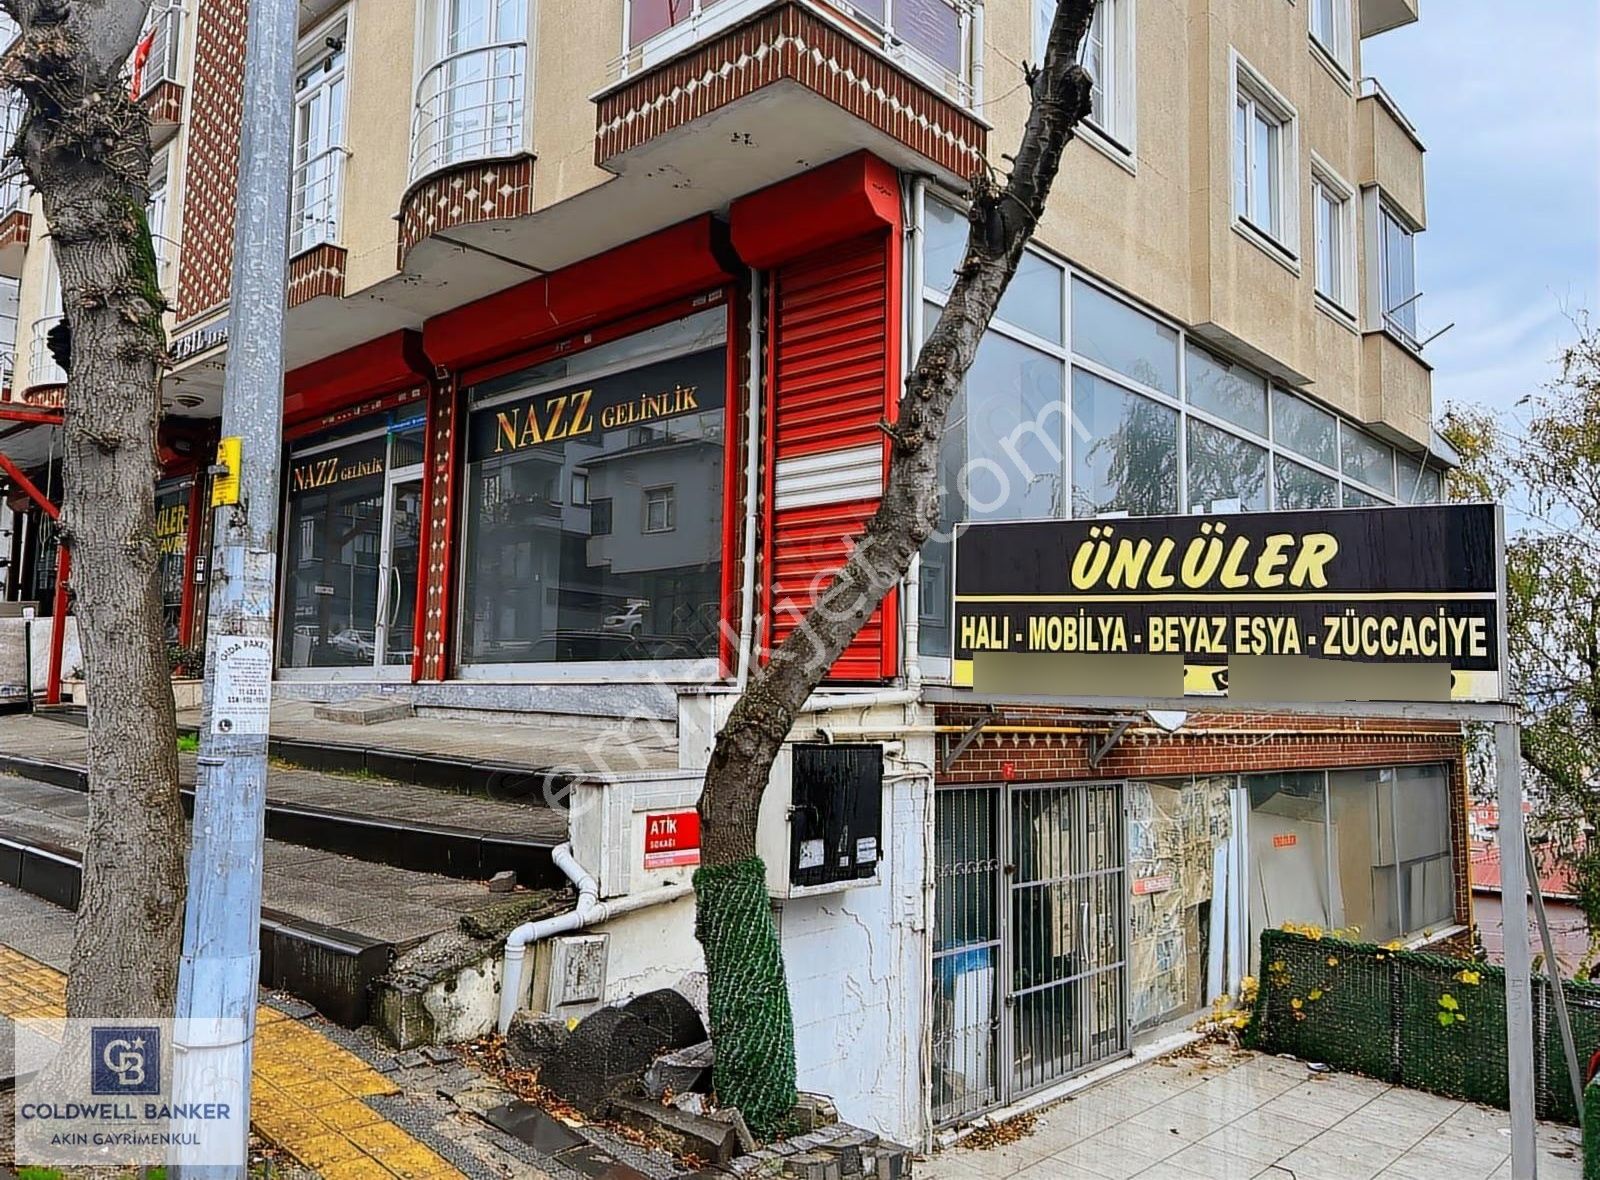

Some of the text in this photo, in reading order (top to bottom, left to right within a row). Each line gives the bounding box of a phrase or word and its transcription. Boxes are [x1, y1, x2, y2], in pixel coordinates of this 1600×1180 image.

[494, 384, 698, 453] NAZZ GELİNLİK
[293, 457, 384, 492] NAZZ GELİNLİK
[1071, 521, 1339, 590] ÜNLÜLER
[961, 615, 1009, 650] HALI
[1028, 608, 1128, 652] MOBİLYA
[1148, 616, 1228, 654] BEYAZ
[1234, 616, 1301, 656] EŞYA
[1323, 607, 1488, 657] ZÜCCACİYE
[650, 816, 677, 836] ATİK
